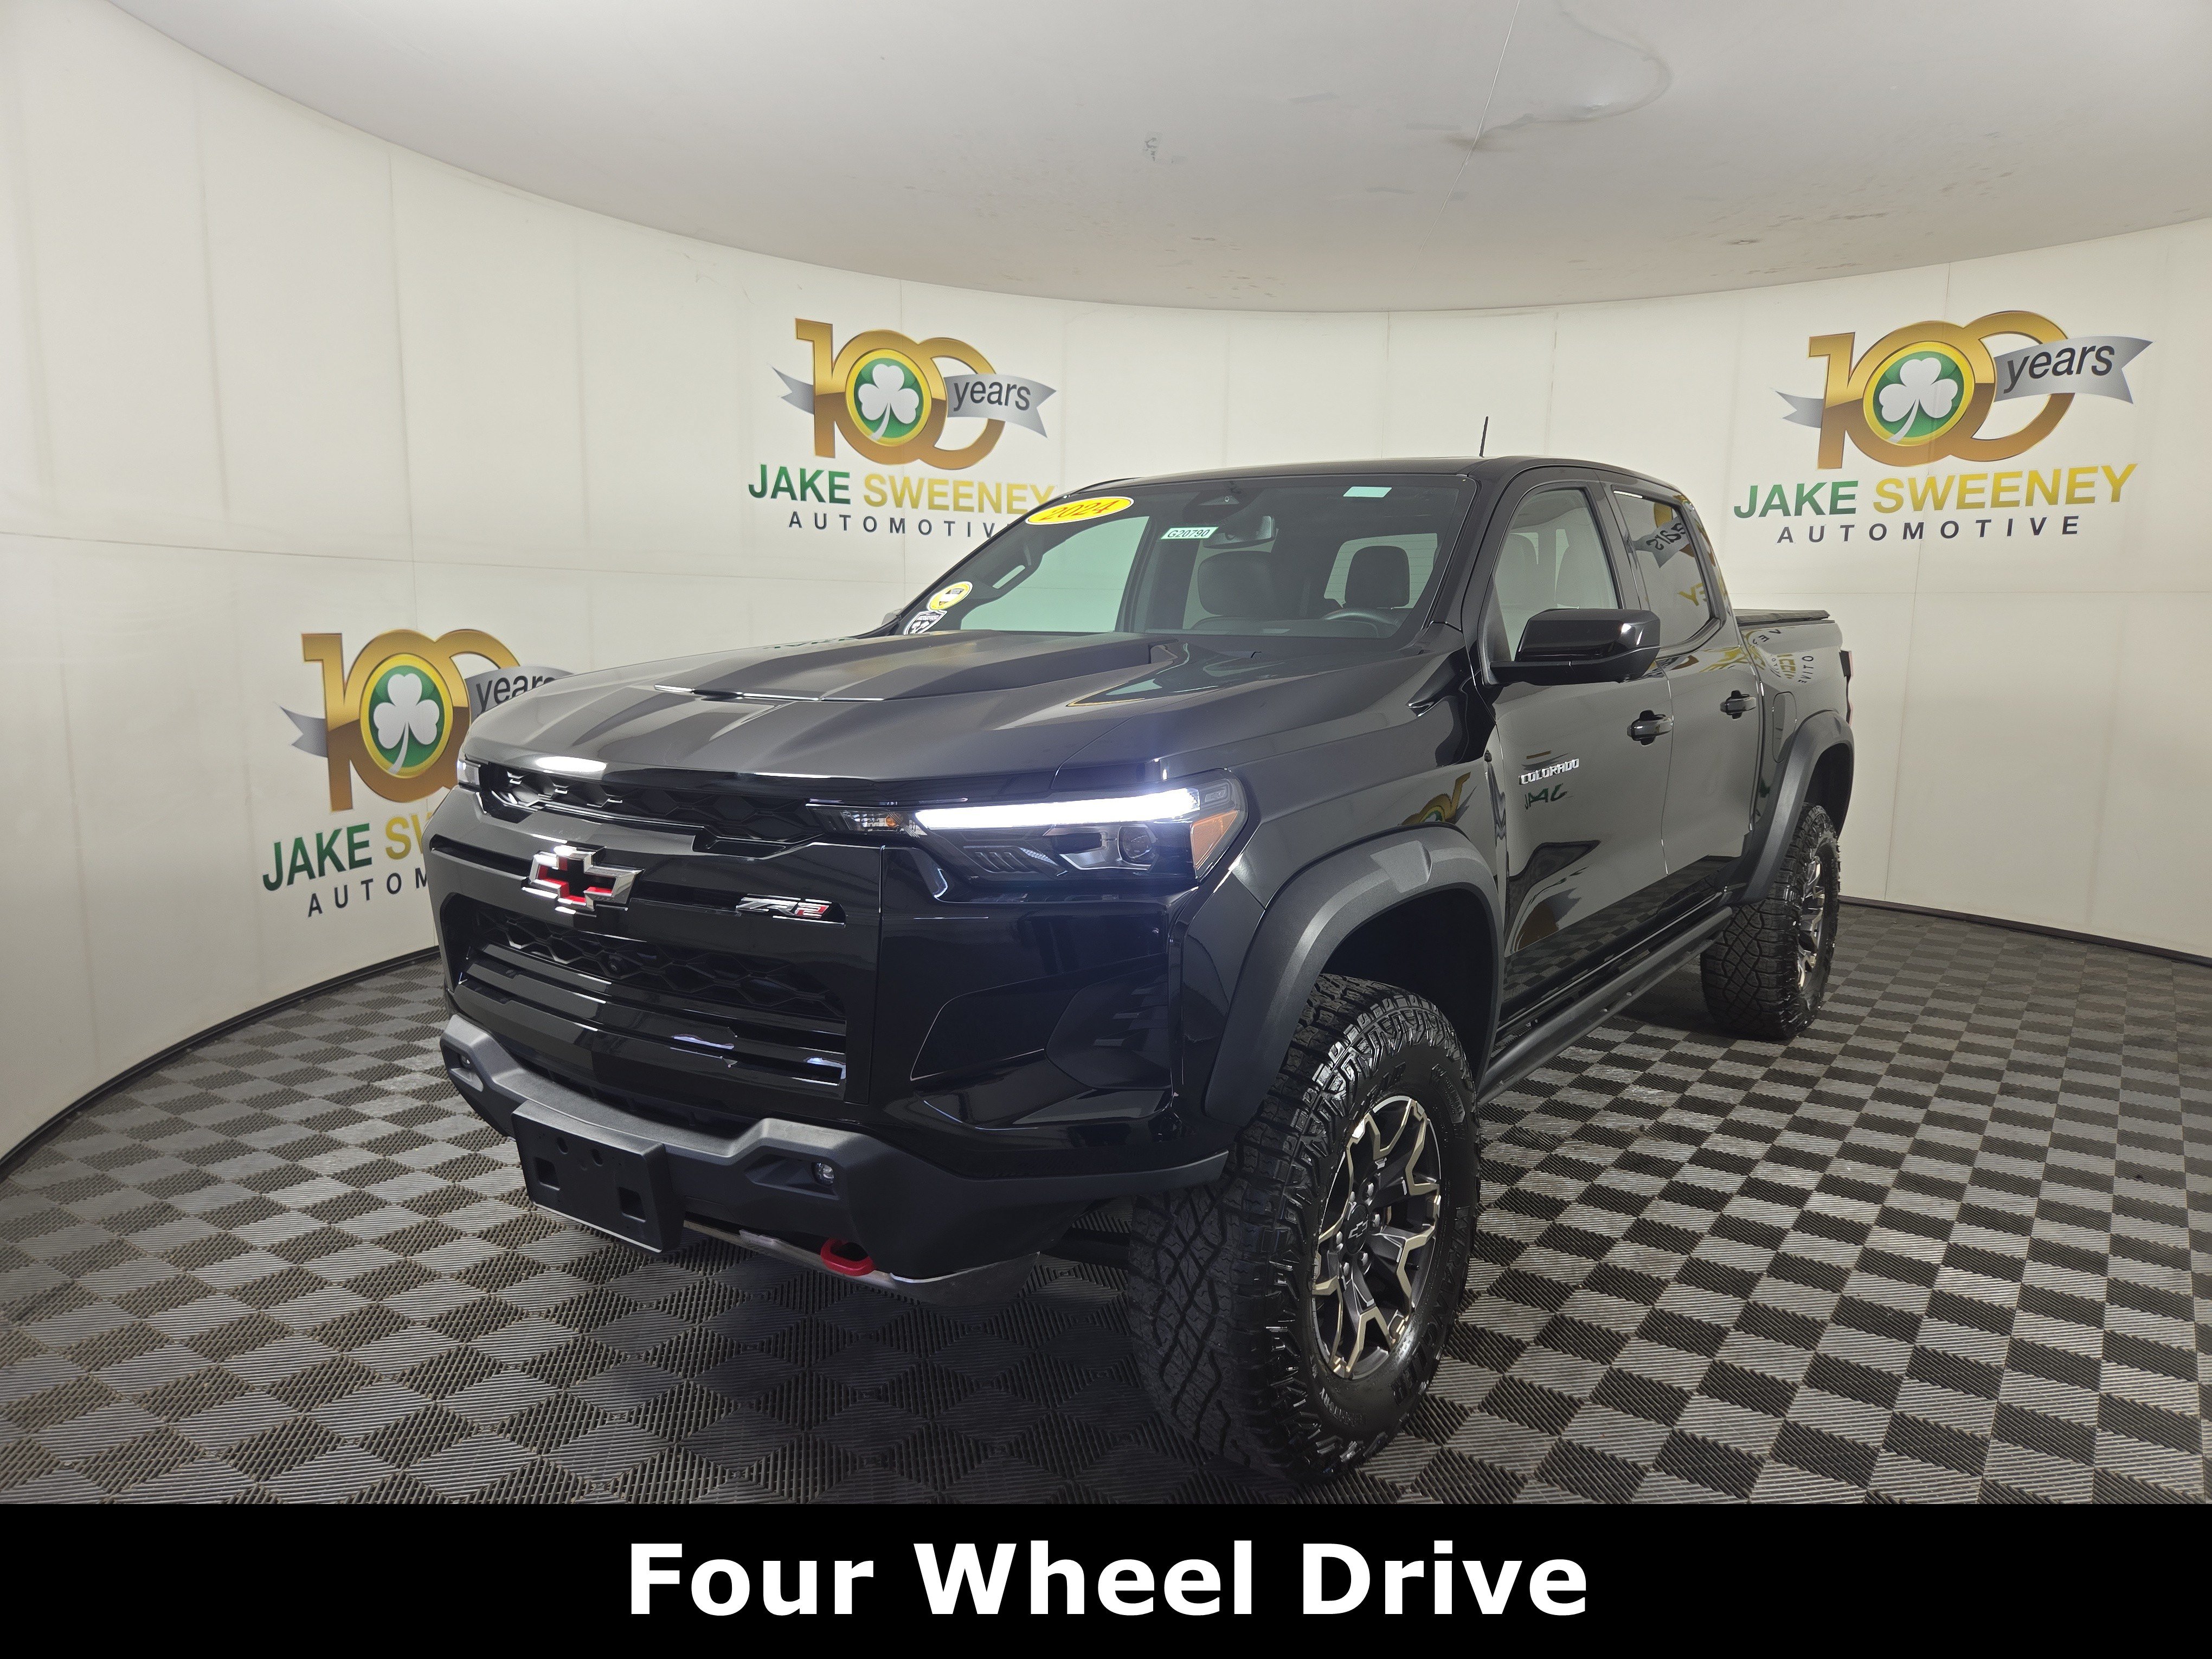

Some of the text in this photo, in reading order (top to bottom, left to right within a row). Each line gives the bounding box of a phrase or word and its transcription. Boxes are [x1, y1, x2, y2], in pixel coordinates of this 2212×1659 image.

[2003, 345, 2115, 394] years
[795, 318, 1005, 470] 100
[953, 380, 1030, 411] years
[1807, 310, 2075, 470] 100
[749, 464, 1055, 515] JAKE SWEENEY
[1734, 463, 2138, 519] JAKE SWEENEY
[789, 511, 1012, 538] AUTOMOTIV
[1039, 499, 1120, 520] 2024
[1167, 529, 1210, 538] G20790
[1776, 515, 2080, 543] AUTOMOTIVE
[476, 676, 554, 713] year
[1520, 758, 1579, 785] COLORADO
[262, 823, 373, 891] JAKE
[307, 867, 427, 917] AUTOM
[736, 897, 829, 918] ZR2
